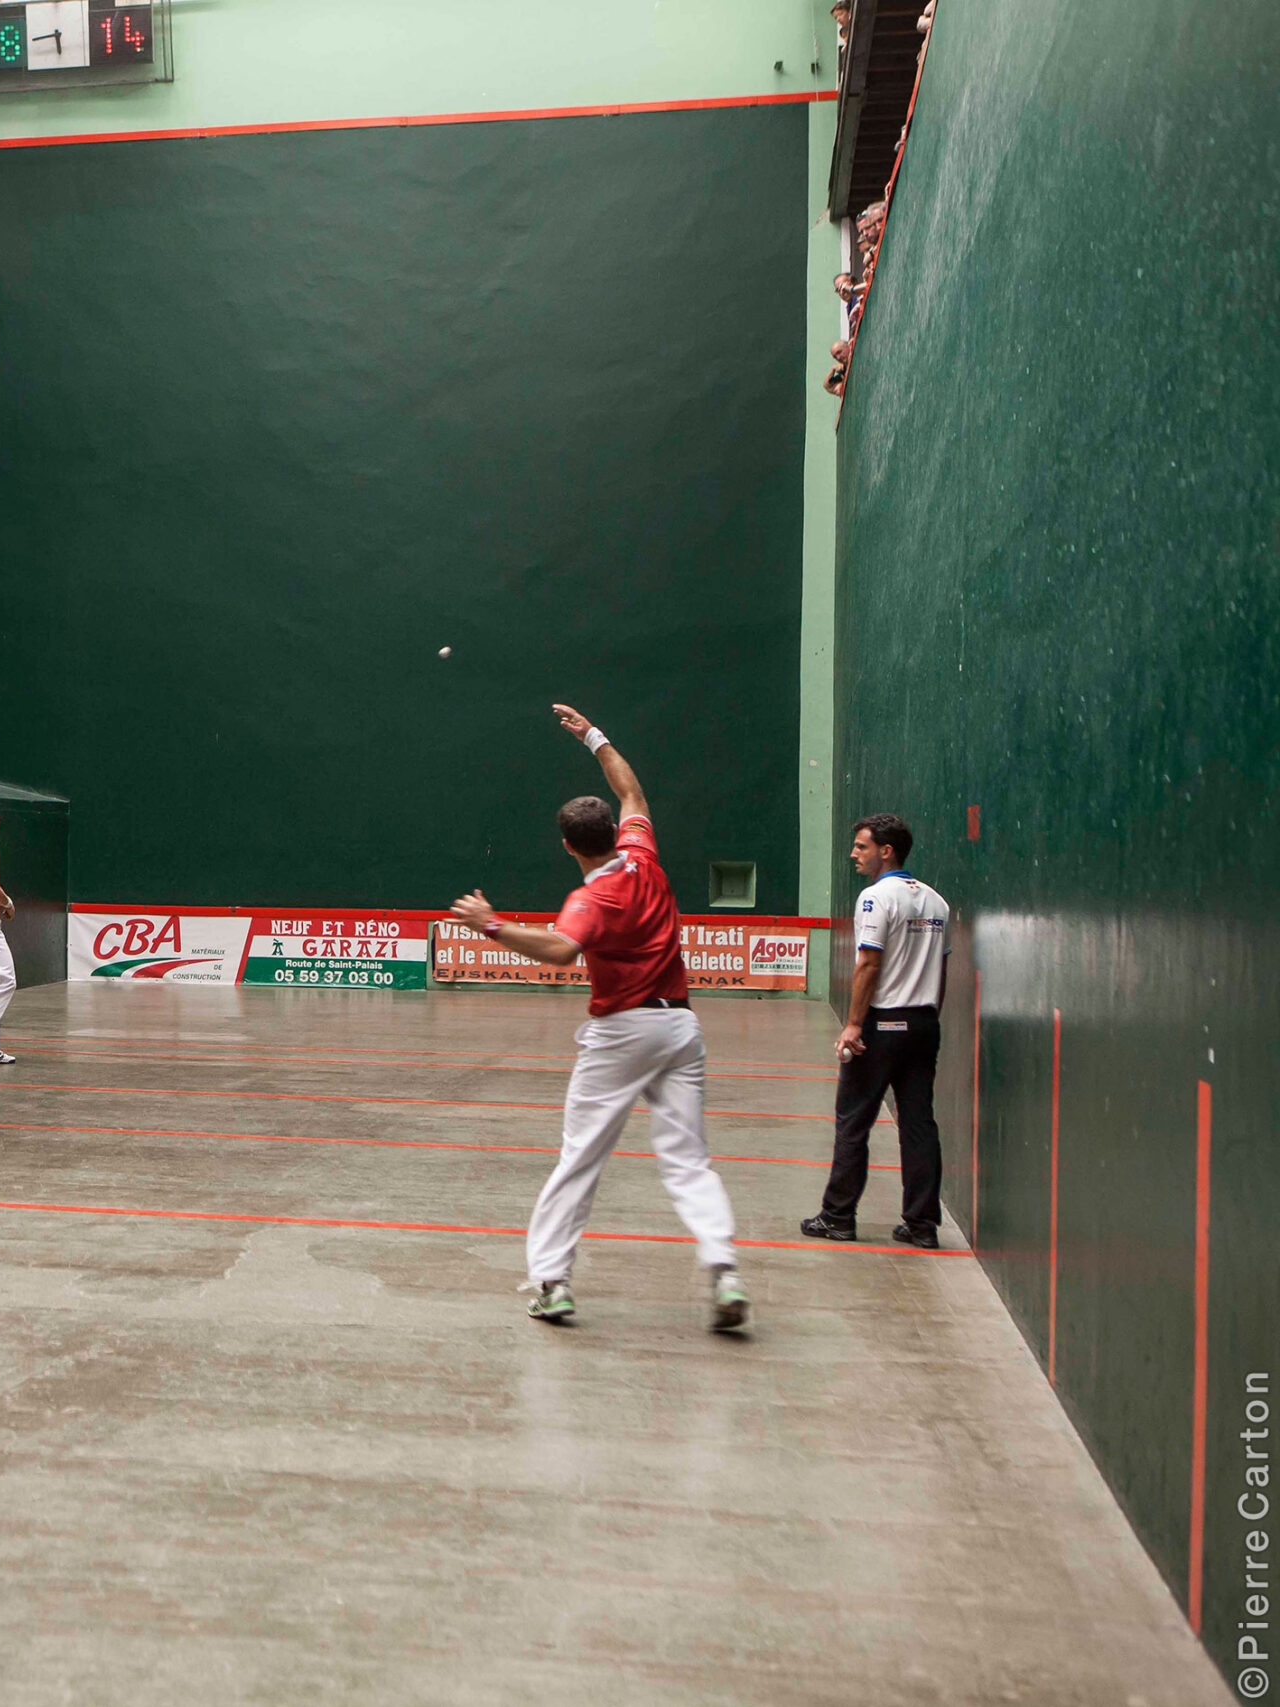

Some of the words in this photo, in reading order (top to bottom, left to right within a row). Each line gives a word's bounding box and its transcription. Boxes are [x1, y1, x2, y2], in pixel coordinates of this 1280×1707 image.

[100, 16, 145, 54] 14
[270, 919, 312, 935] NEUF
[322, 921, 344, 936] ET
[354, 919, 400, 937] RÉNO
[92, 915, 182, 960] CBA
[437, 946, 454, 965] et
[459, 946, 475, 965] le
[751, 938, 805, 962] Agour
[285, 960, 312, 968] Route
[314, 960, 326, 968] de
[328, 960, 383, 970] Saint-Palais
[274, 969, 294, 983] 05
[299, 970, 319, 983] 59
[323, 971, 343, 984] 37
[348, 971, 368, 984] 03
[373, 972, 394, 985] 00
[436, 968, 527, 981] EUSKAL
